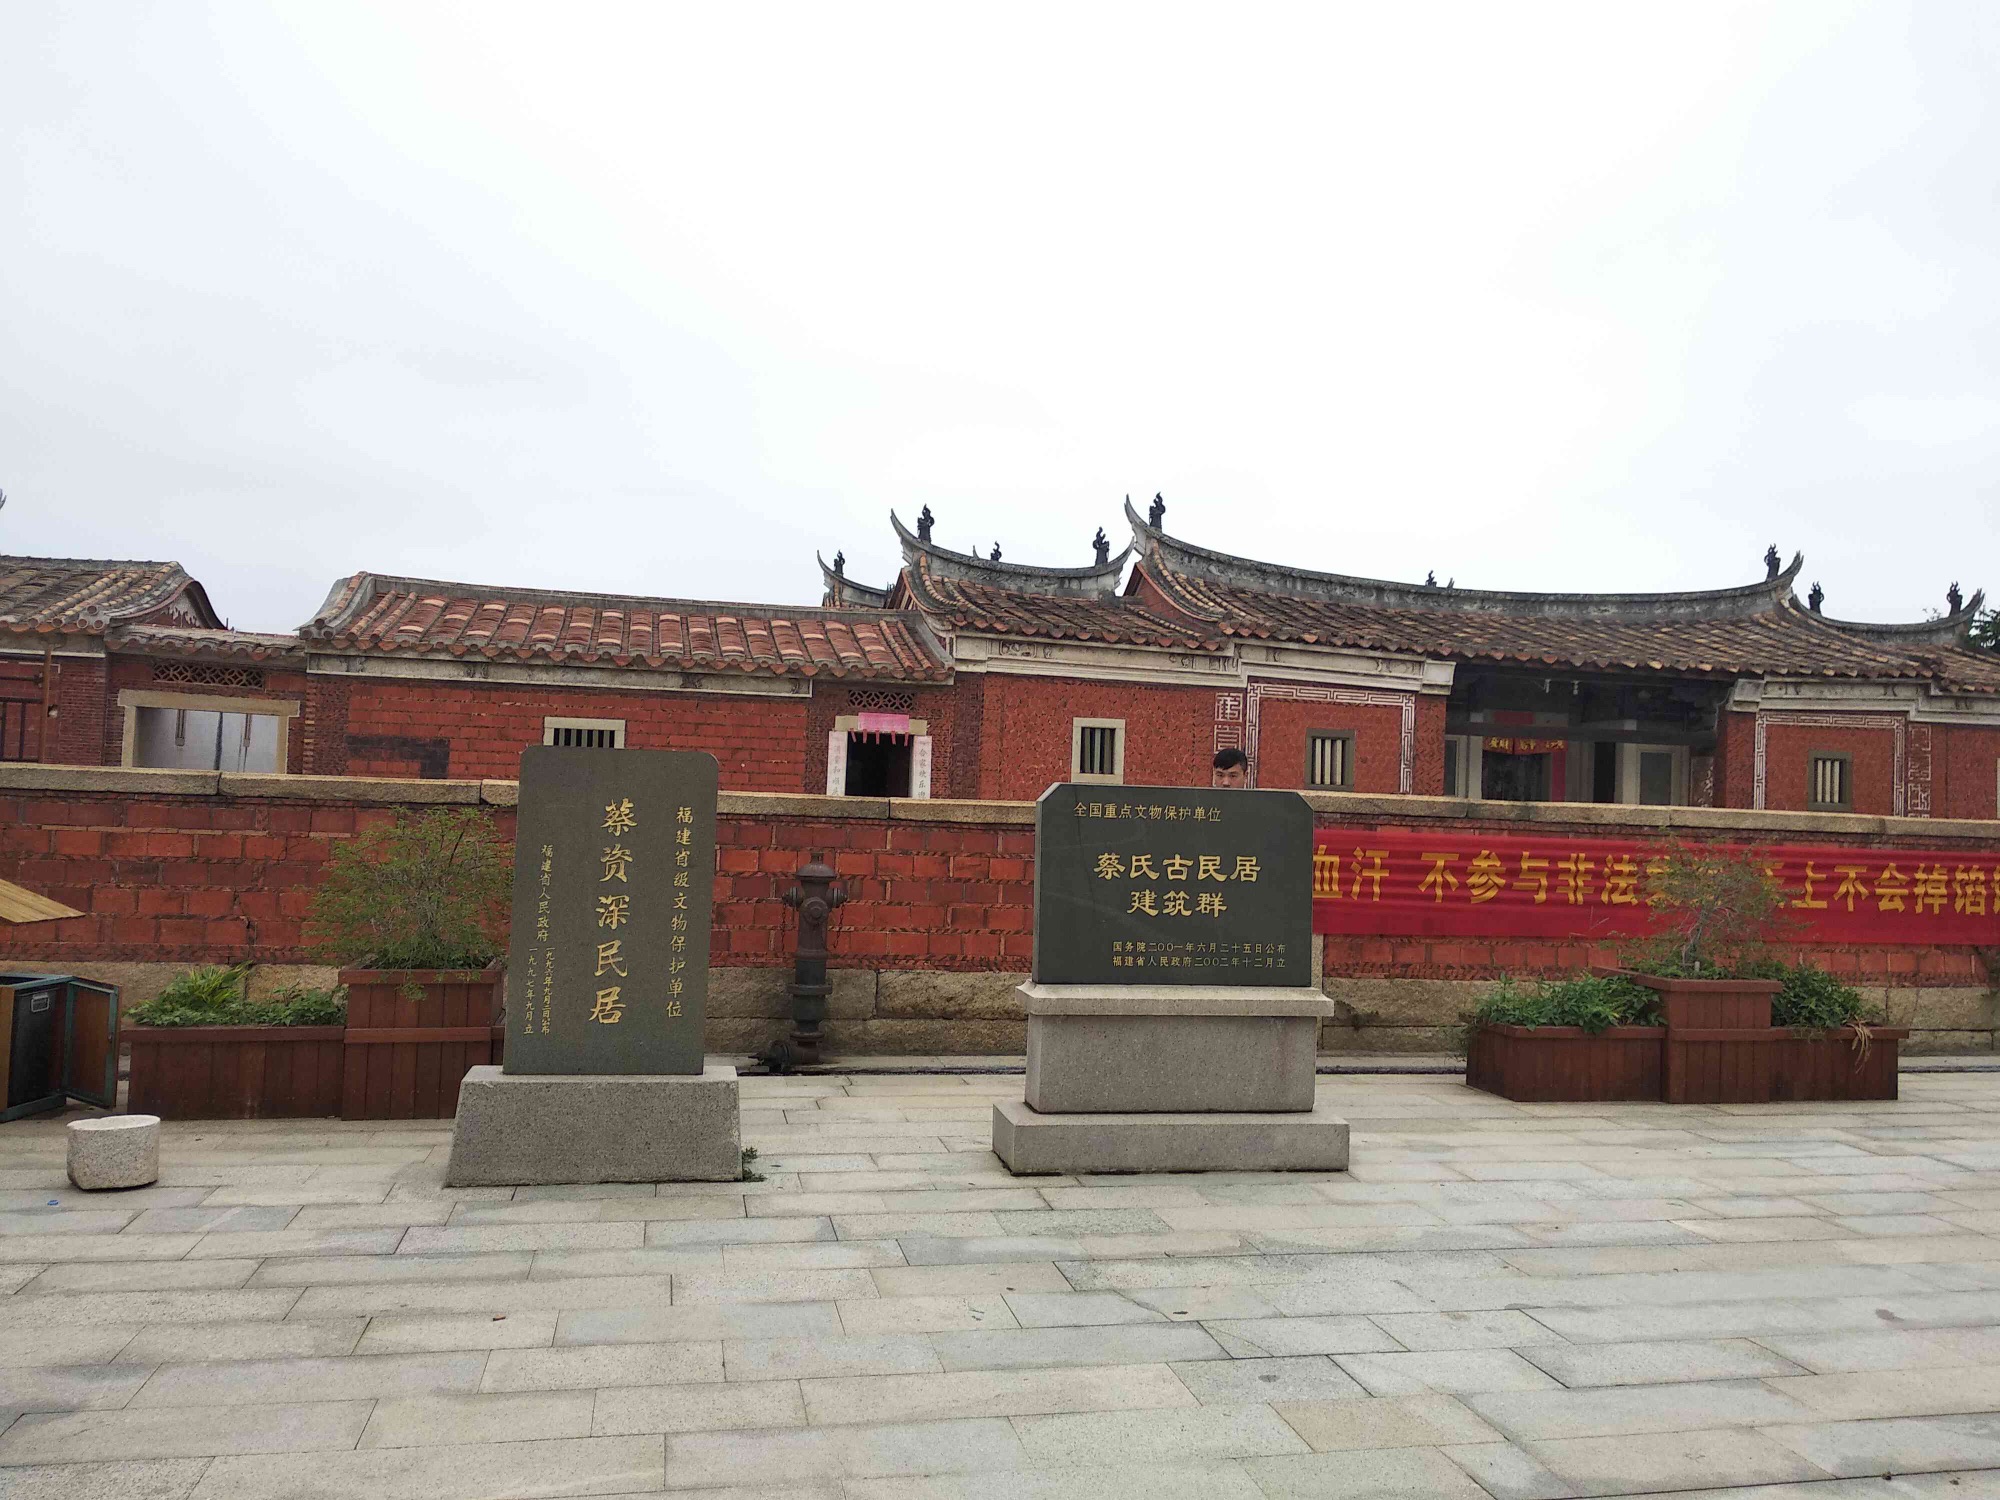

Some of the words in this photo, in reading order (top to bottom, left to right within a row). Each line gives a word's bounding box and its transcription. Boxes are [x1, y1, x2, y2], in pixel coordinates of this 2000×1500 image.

[1073, 802, 1222, 822] 全国重点文物保护单位
[536, 844, 553, 942] 福建省人民政府
[1093, 852, 1261, 882] 蔡氏古民居
[1313, 844, 1390, 902] 血汗
[588, 797, 638, 1024] 蔡资深民居
[666, 806, 694, 1018] 福建省级文物保护单位
[1126, 889, 1228, 918] 建筑群
